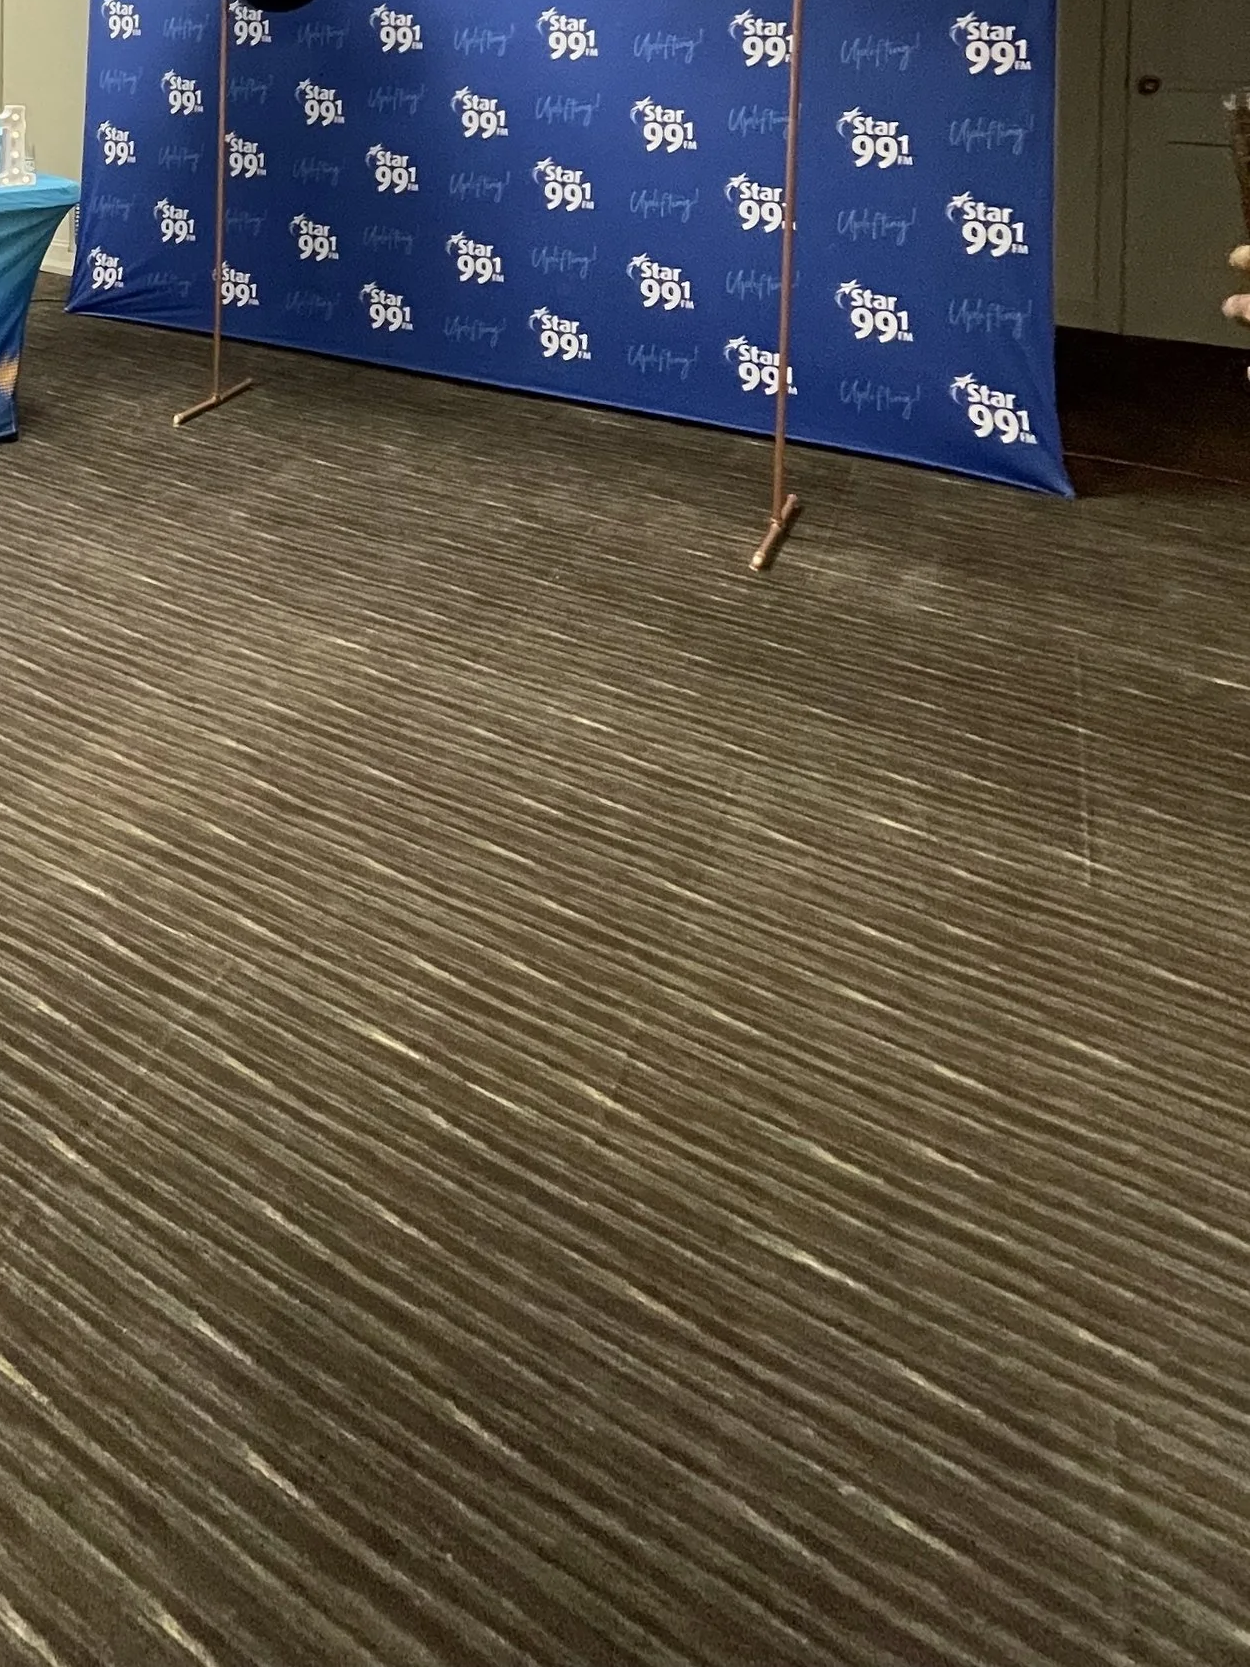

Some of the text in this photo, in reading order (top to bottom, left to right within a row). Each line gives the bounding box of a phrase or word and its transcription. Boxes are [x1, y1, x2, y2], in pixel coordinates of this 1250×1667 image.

[109, 1, 134, 15] Star
[235, 6, 263, 20] Star
[380, 11, 414, 26] Star
[109, 15, 140, 39] 991
[234, 20, 269, 46] 991
[550, 14, 587, 32] Star
[744, 18, 786, 36] Star
[967, 21, 1016, 41] Star
[380, 25, 420, 53] 991
[549, 30, 595, 61] 991
[965, 39, 1027, 75] 991
[169, 76, 196, 91] Star
[305, 85, 336, 100] Star
[169, 90, 202, 115] 991
[304, 100, 342, 126] 991
[462, 94, 497, 111] Star
[644, 105, 685, 123] Star
[105, 127, 129, 141] Star
[461, 110, 506, 139] 991
[853, 116, 899, 135] Star
[230, 138, 258, 153] Star
[643, 122, 693, 153] 991
[104, 141, 135, 166] 991
[376, 150, 409, 167] Star
[851, 135, 909, 169] 991
[229, 153, 264, 178] 991
[545, 166, 583, 184] Star
[375, 166, 416, 194] 991
[544, 183, 591, 212] 991
[740, 183, 782, 202] Star
[162, 205, 189, 220] Star
[739, 200, 788, 233] 99
[962, 201, 1013, 222] Star
[160, 219, 194, 244] 991
[300, 219, 330, 236] Star
[962, 221, 1024, 257] 991
[95, 252, 119, 267] Star
[298, 235, 337, 261] 991
[458, 239, 494, 257] Star
[92, 266, 123, 290] 991
[222, 268, 250, 283] Star
[457, 256, 502, 284] 991
[640, 262, 681, 281] Star
[221, 282, 257, 307] 991
[370, 289, 403, 306] Star
[640, 279, 690, 311] 991
[850, 289, 897, 312] Star
[370, 304, 411, 332] 991
[541, 314, 580, 334] Star
[850, 308, 908, 343] 991
[540, 331, 588, 361] 991
[968, 383, 1016, 409] Star
[968, 404, 1029, 444] 991
